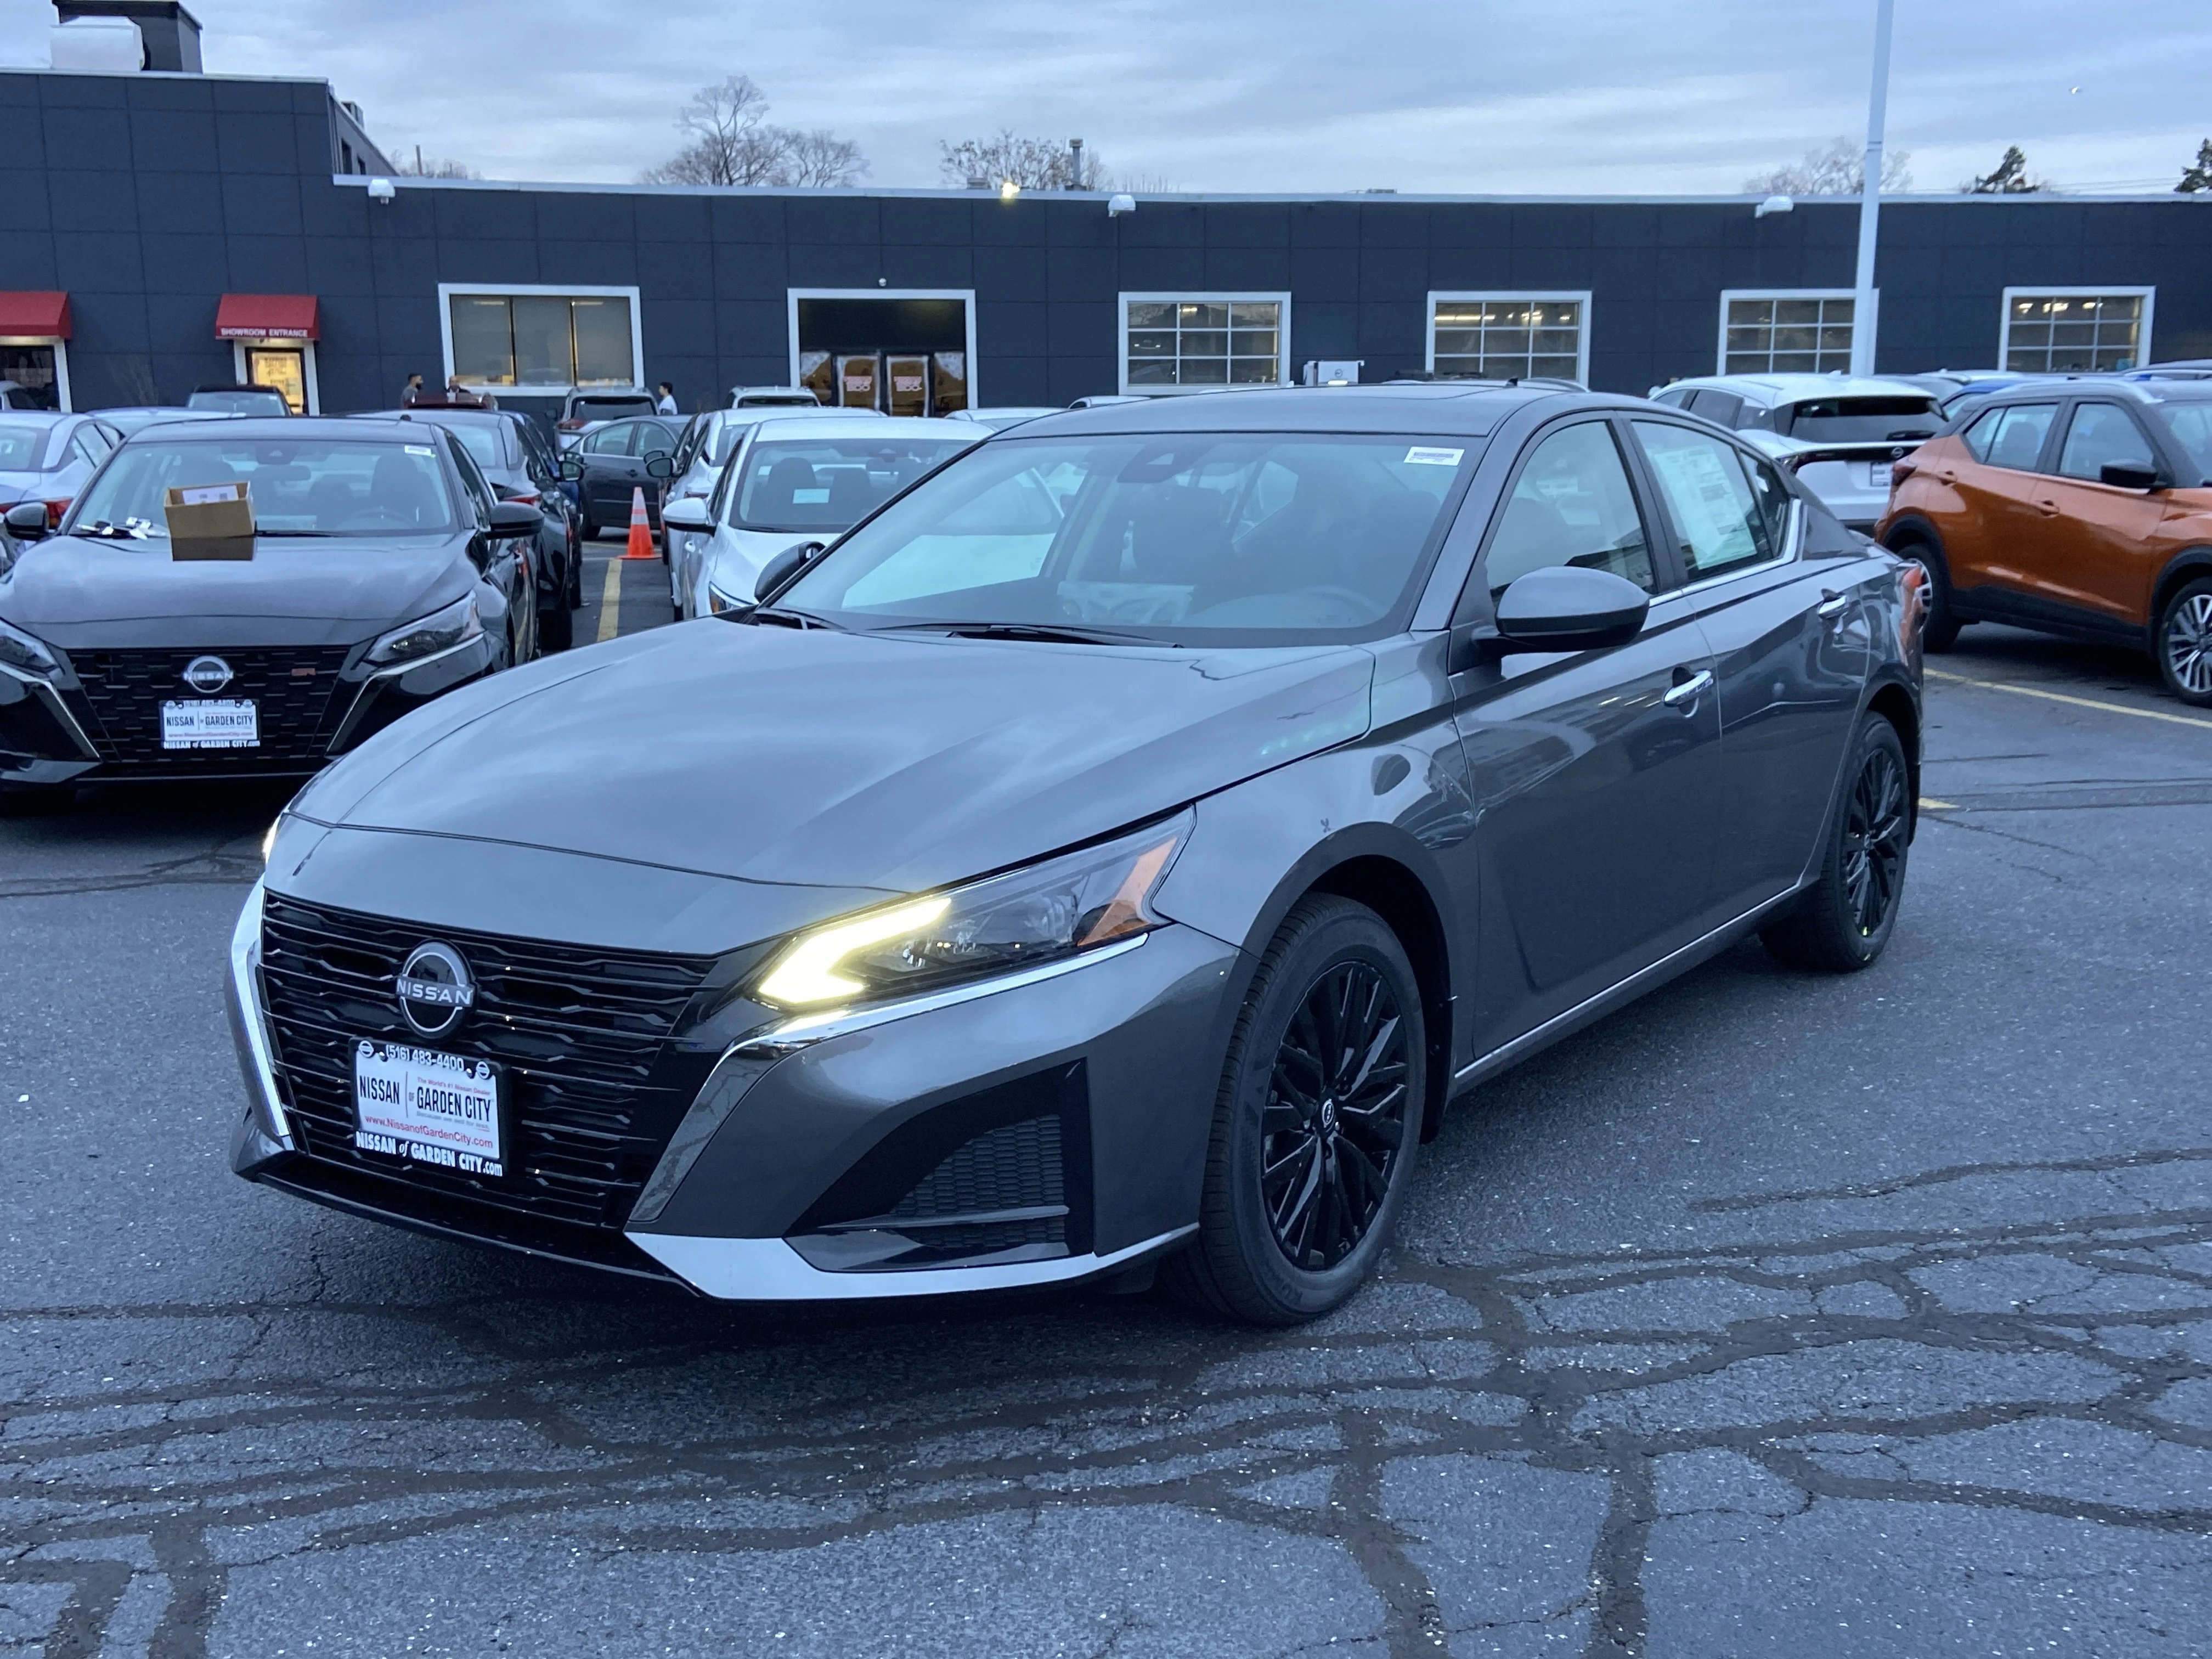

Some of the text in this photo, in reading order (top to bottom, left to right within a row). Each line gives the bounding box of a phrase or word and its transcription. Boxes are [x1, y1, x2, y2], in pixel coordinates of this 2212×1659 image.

[221, 328, 308, 337] SHOWROOM ENTRANCE
[183, 671, 234, 681] NISSAN
[166, 716, 194, 726] NISSAN
[205, 715, 235, 726] GARDEN
[236, 715, 253, 725] CITY
[397, 979, 472, 1005] NISSAN
[386, 1044, 464, 1071] (516) 483-4400
[359, 1075, 400, 1105] NISSAN
[417, 1086, 461, 1116] GARDEN
[465, 1095, 491, 1121] CITY
[365, 1115, 493, 1149] www.NissanofGardenCity.com
[357, 1131, 503, 1177] NISSAN of GARDEN CITY.com
